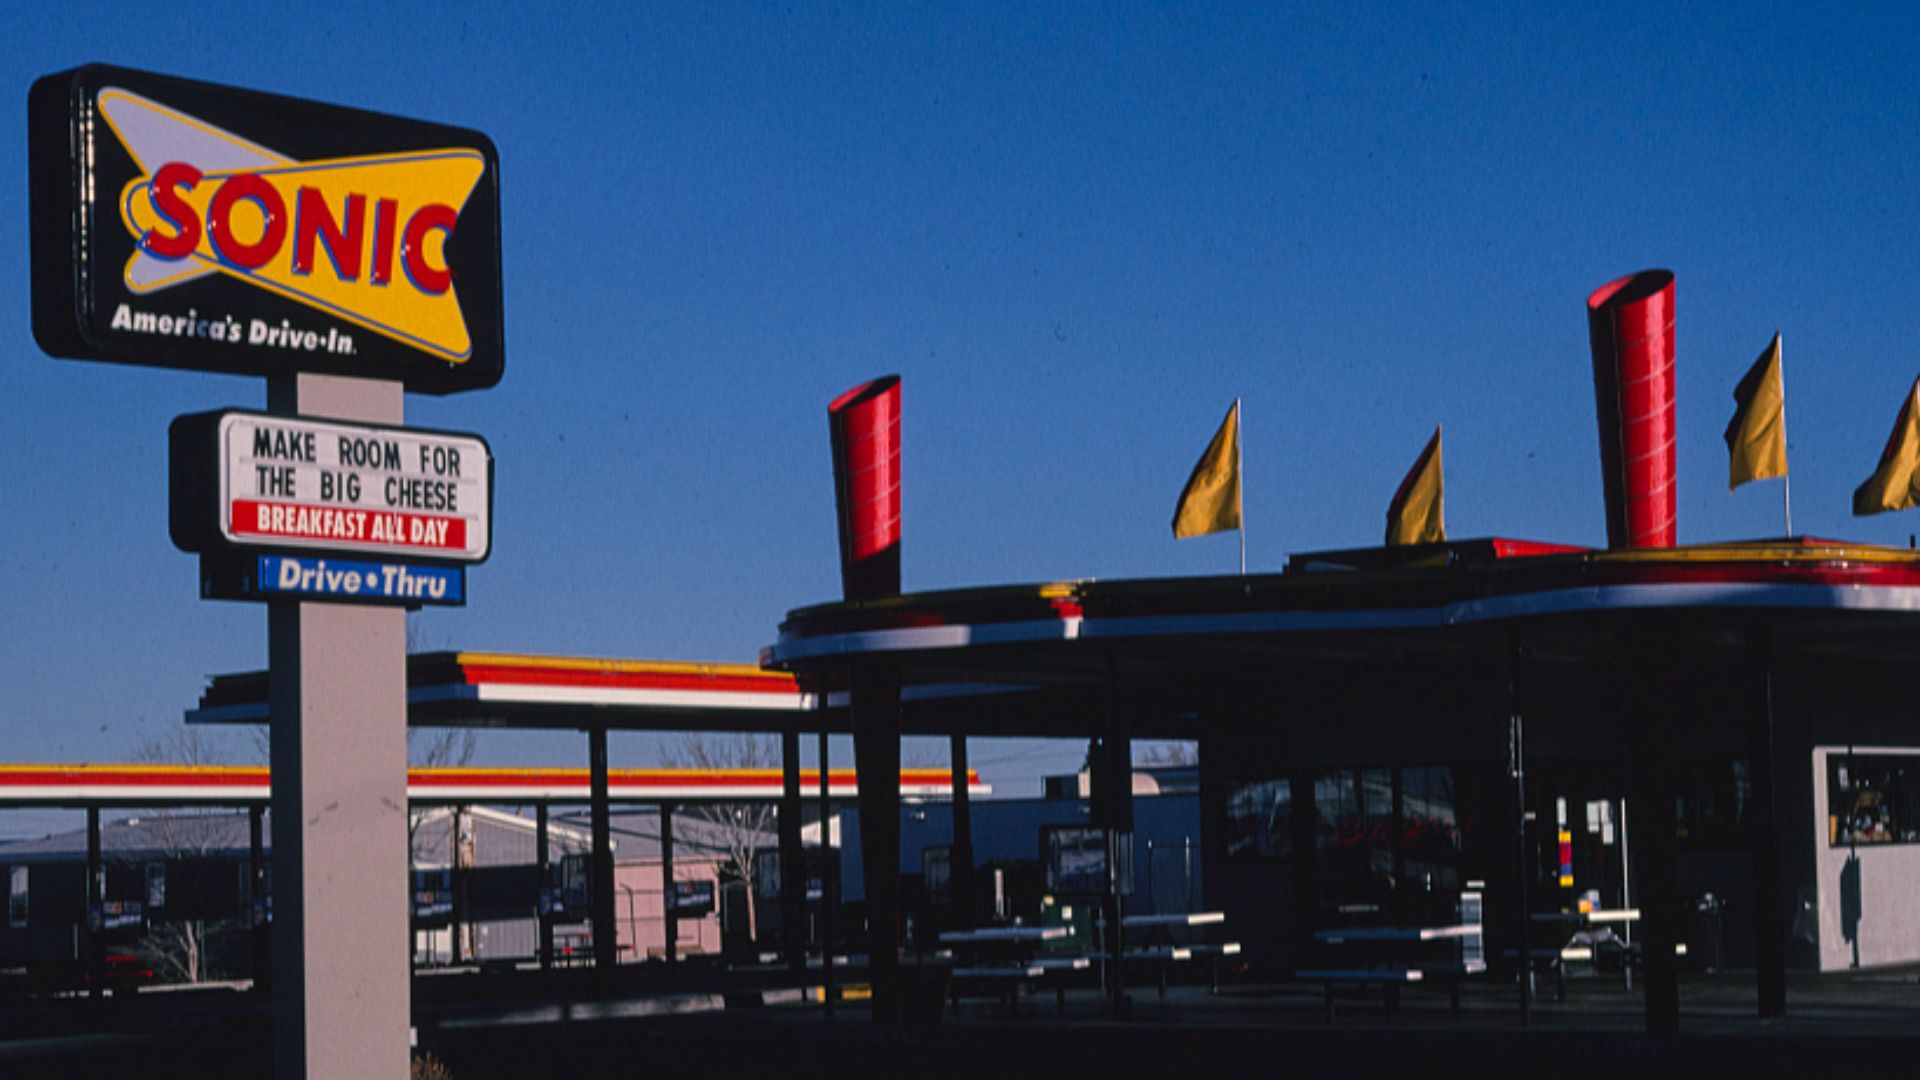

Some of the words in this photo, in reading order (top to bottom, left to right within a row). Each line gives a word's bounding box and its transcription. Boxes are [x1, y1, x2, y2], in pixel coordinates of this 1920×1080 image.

[136, 162, 458, 296] SONIC
[111, 303, 242, 342] America's
[253, 427, 316, 462] MAKE
[339, 436, 401, 471] ROOM
[420, 445, 460, 477] FOR
[255, 465, 296, 497] THE
[321, 472, 360, 502] BIG
[384, 477, 457, 511] CHEESE
[257, 503, 365, 538] BREAKFAST
[371, 512, 405, 544] ALL
[410, 517, 449, 545] DAY
